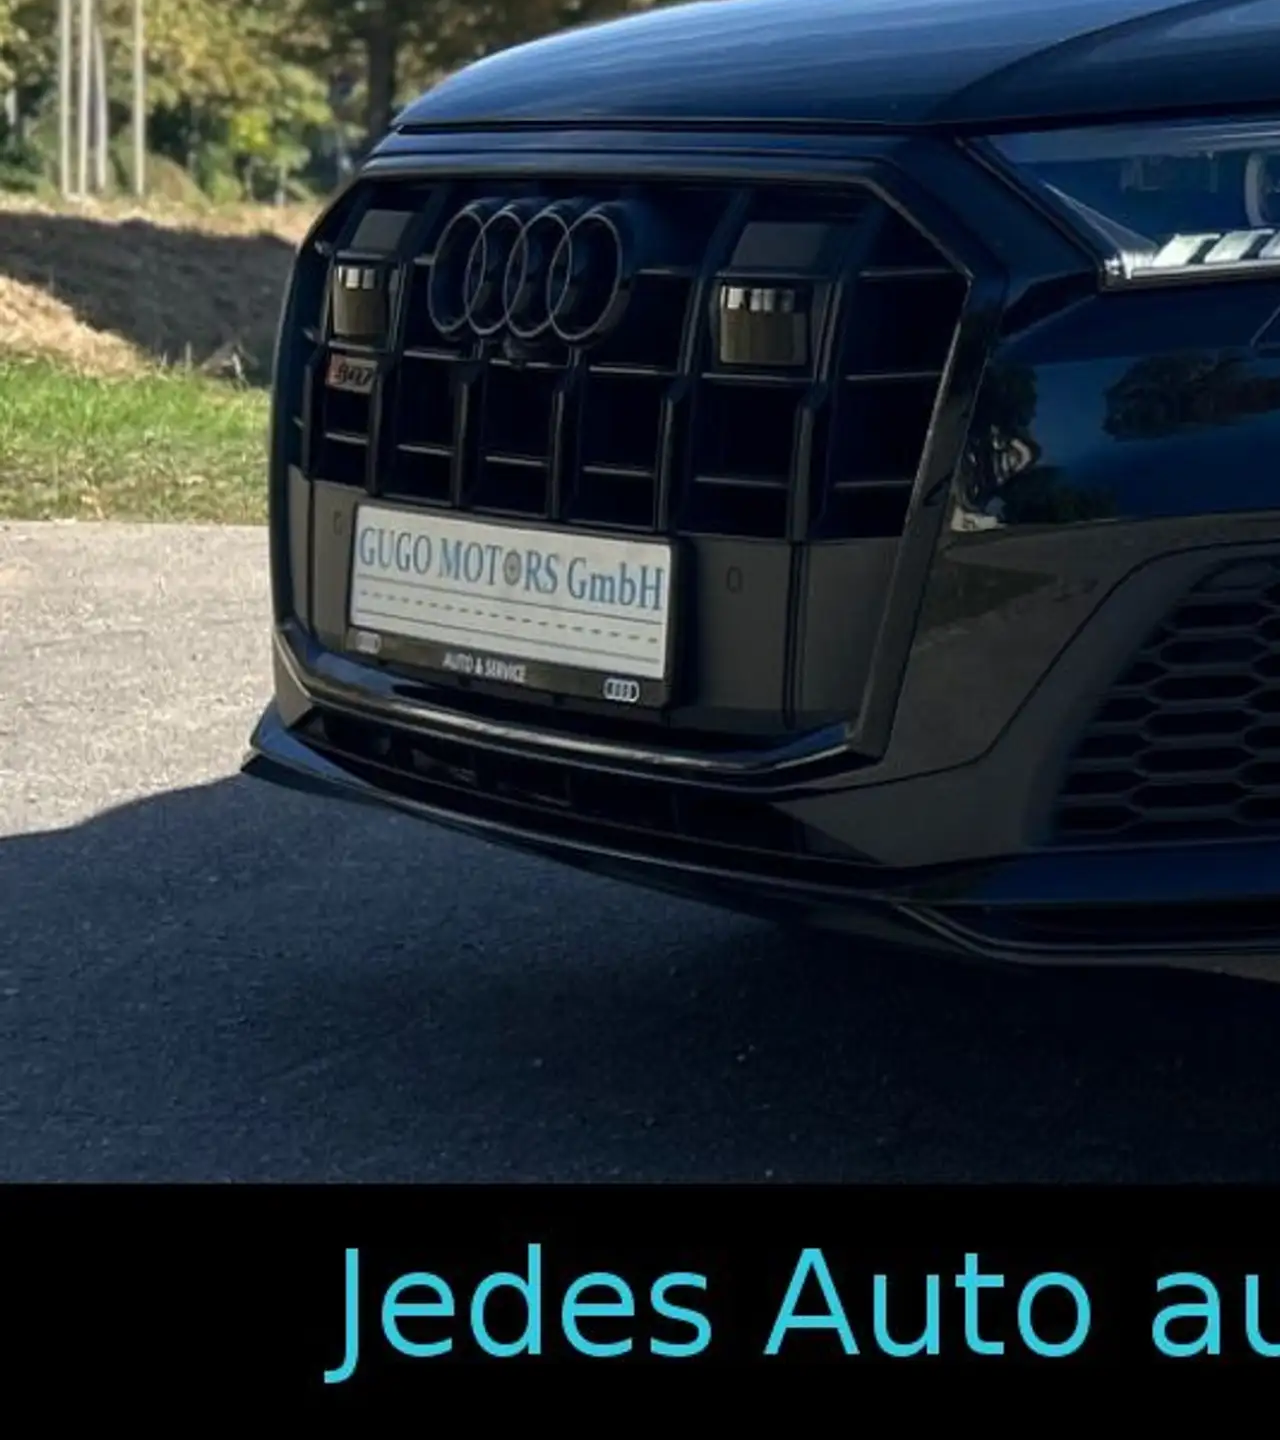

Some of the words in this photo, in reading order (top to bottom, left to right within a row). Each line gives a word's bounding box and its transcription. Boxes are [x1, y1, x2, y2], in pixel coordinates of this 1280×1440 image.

[359, 526, 432, 574] GUGO
[438, 537, 560, 594] MOTORS
[567, 556, 664, 611] GmbH
[442, 651, 474, 675] AUTO
[484, 659, 528, 683] SERVICE
